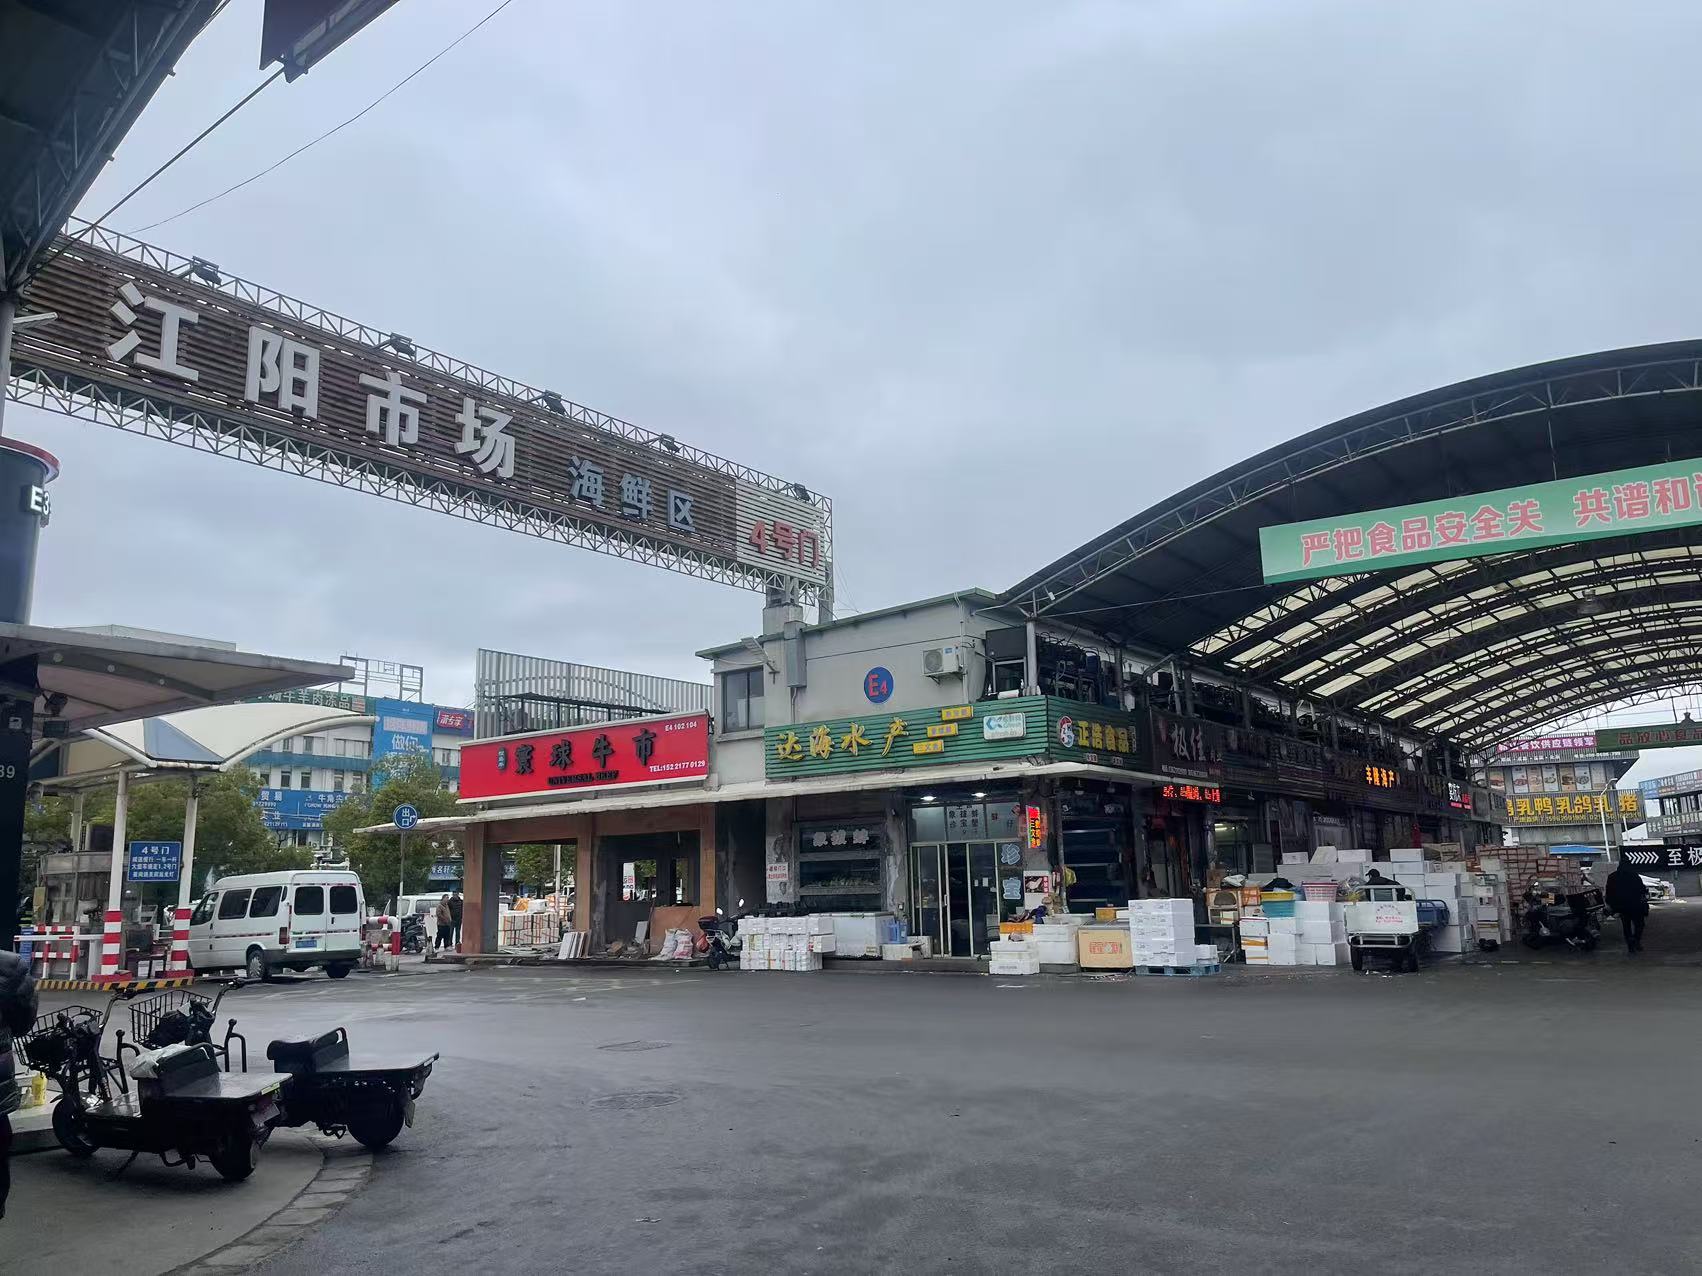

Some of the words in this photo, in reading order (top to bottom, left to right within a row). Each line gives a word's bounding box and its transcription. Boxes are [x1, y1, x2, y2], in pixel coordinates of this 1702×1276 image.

[105, 282, 515, 478] 江阳市场
[567, 455, 696, 532] 海鲜区
[749, 519, 819, 569] 4号门
[30, 485, 50, 515] E3
[1301, 499, 1544, 566] 严把食品安全关
[1573, 474, 1702, 528] 共谱和
[868, 674, 888, 696] E4
[776, 717, 910, 761] 达海水产
[401, 808, 411, 826] 出口
[141, 846, 170, 855] 4号门
